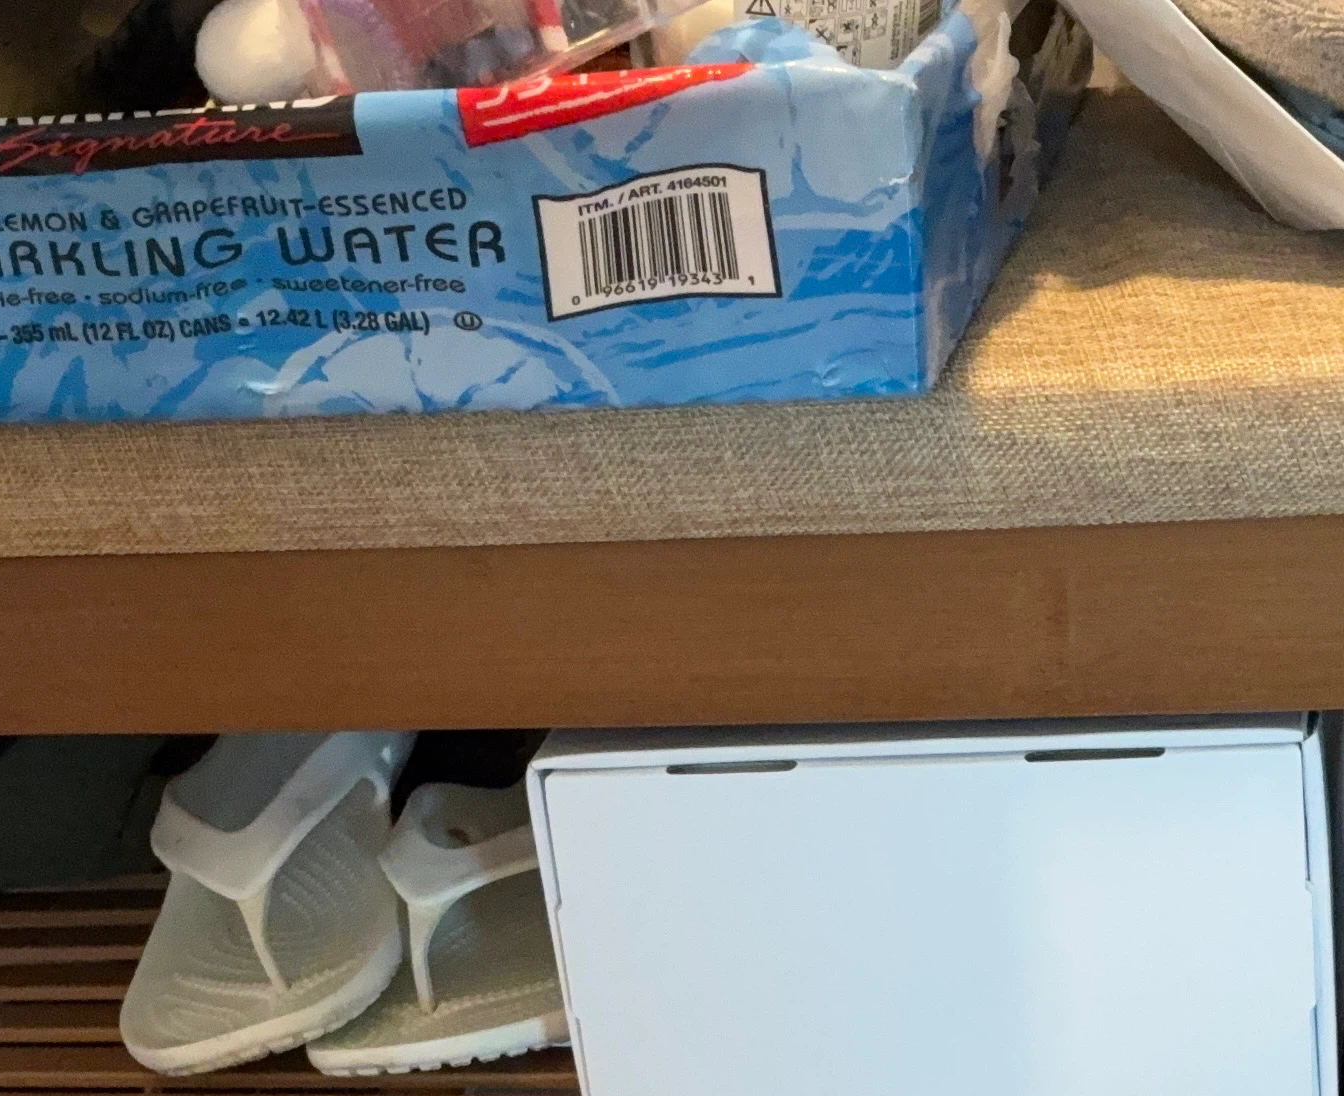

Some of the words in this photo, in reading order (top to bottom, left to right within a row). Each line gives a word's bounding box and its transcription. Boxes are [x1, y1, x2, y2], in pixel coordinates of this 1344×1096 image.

[100, 209, 121, 231] &
[132, 187, 467, 229] GRAPEFRUIT-ESSENCED
[577, 200, 614, 217] ITM.
[628, 183, 662, 201] ART.
[276, 220, 506, 268] WATER
[99, 277, 248, 306] sodium-free
[271, 274, 467, 294] sweetener-free
[571, 295, 581, 306] 0
[747, 275, 756, 286] 1
[48, 321, 80, 343] mL
[82, 321, 114, 345] (12
[116, 321, 141, 342] FL
[142, 319, 177, 343] OZ)
[179, 313, 232, 338] CANS
[255, 308, 311, 334] 12.42
[313, 310, 329, 330] L
[332, 309, 380, 334] (3.28
[383, 310, 431, 335] GAL)
